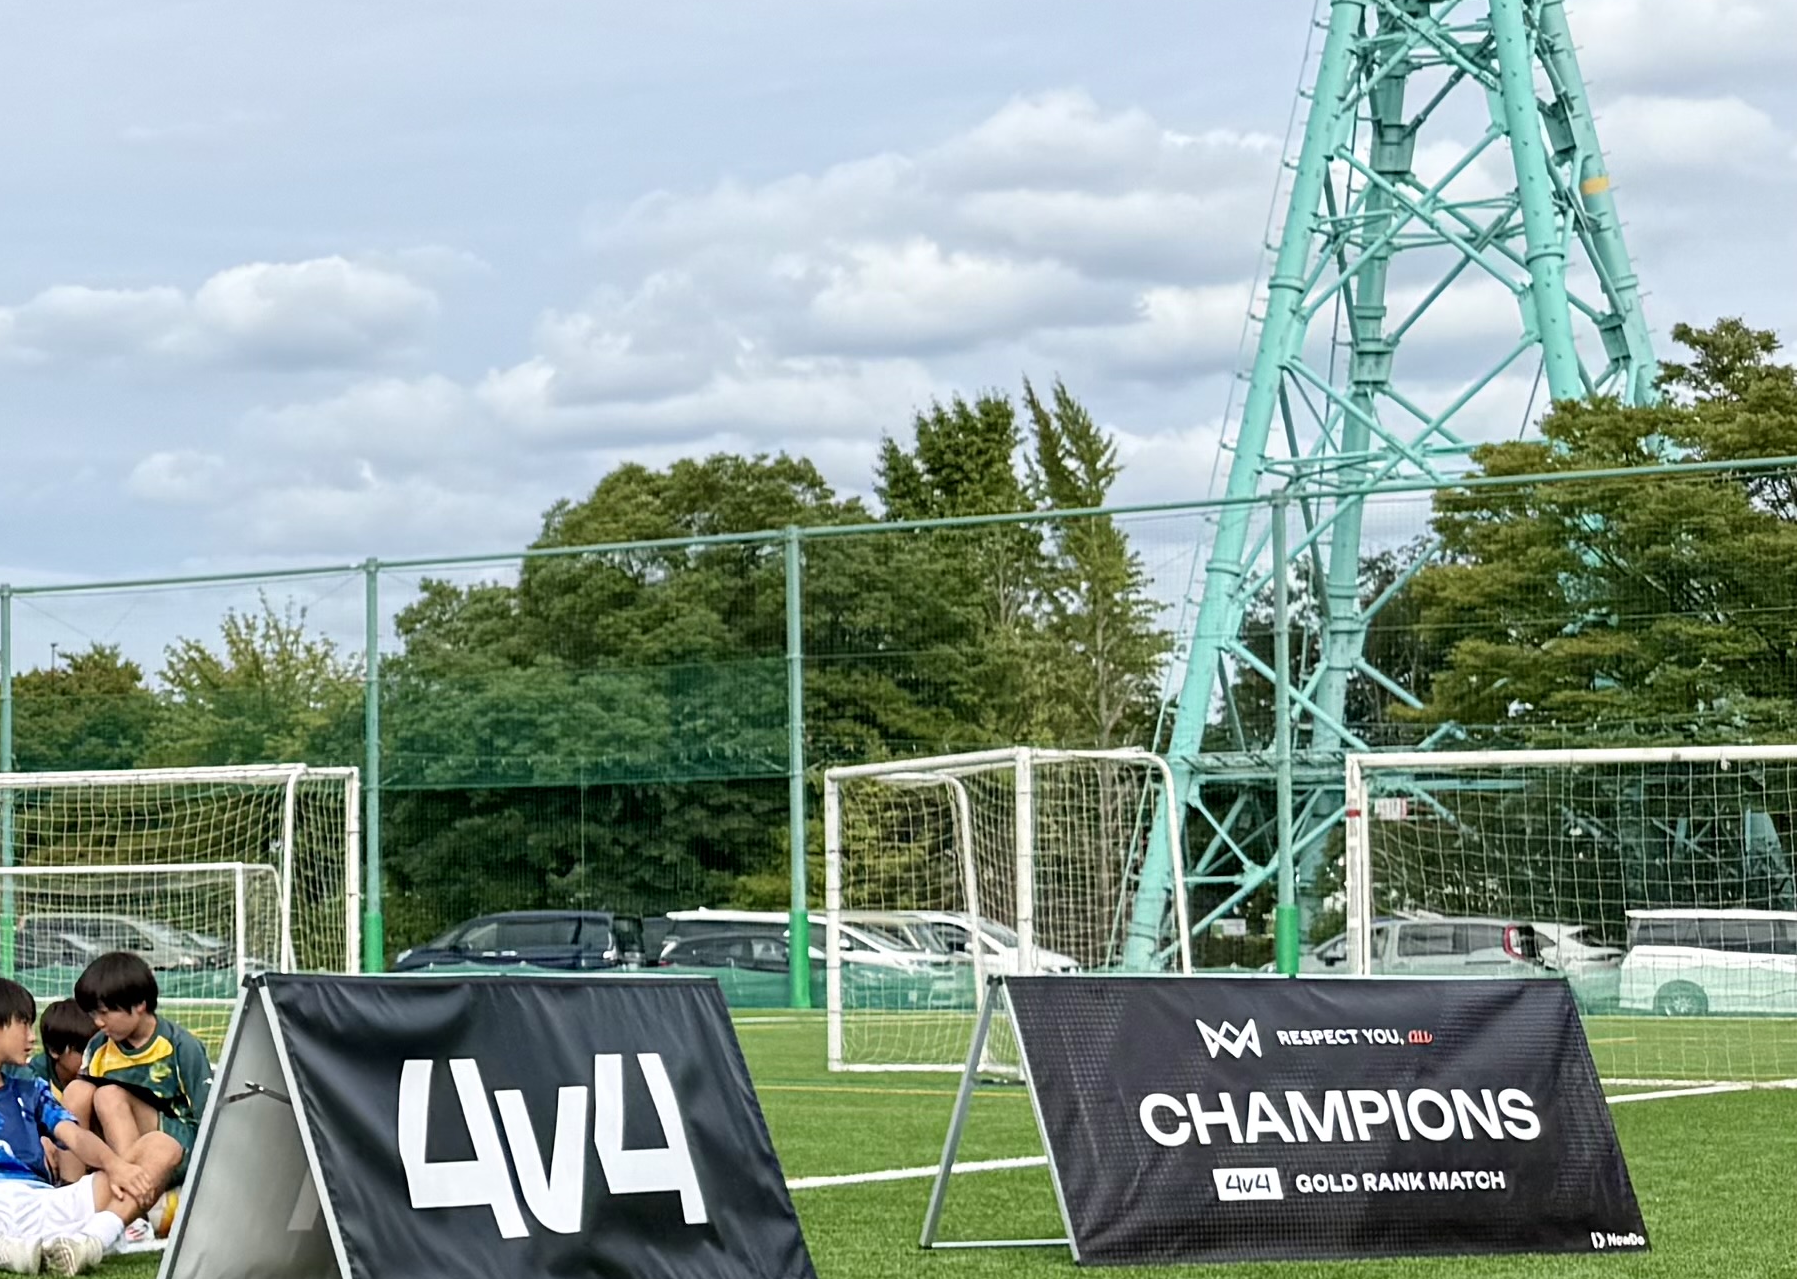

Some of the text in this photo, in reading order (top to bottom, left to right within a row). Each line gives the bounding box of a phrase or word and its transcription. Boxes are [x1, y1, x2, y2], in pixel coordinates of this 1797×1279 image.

[1276, 1028, 1433, 1046] RESPECT YOU, au
[1138, 1088, 1542, 1147] CHAMPIONS
[397, 1052, 708, 1239] 4v4
[1225, 1170, 1507, 1194] 4v4 GOLD RANK MATCH
